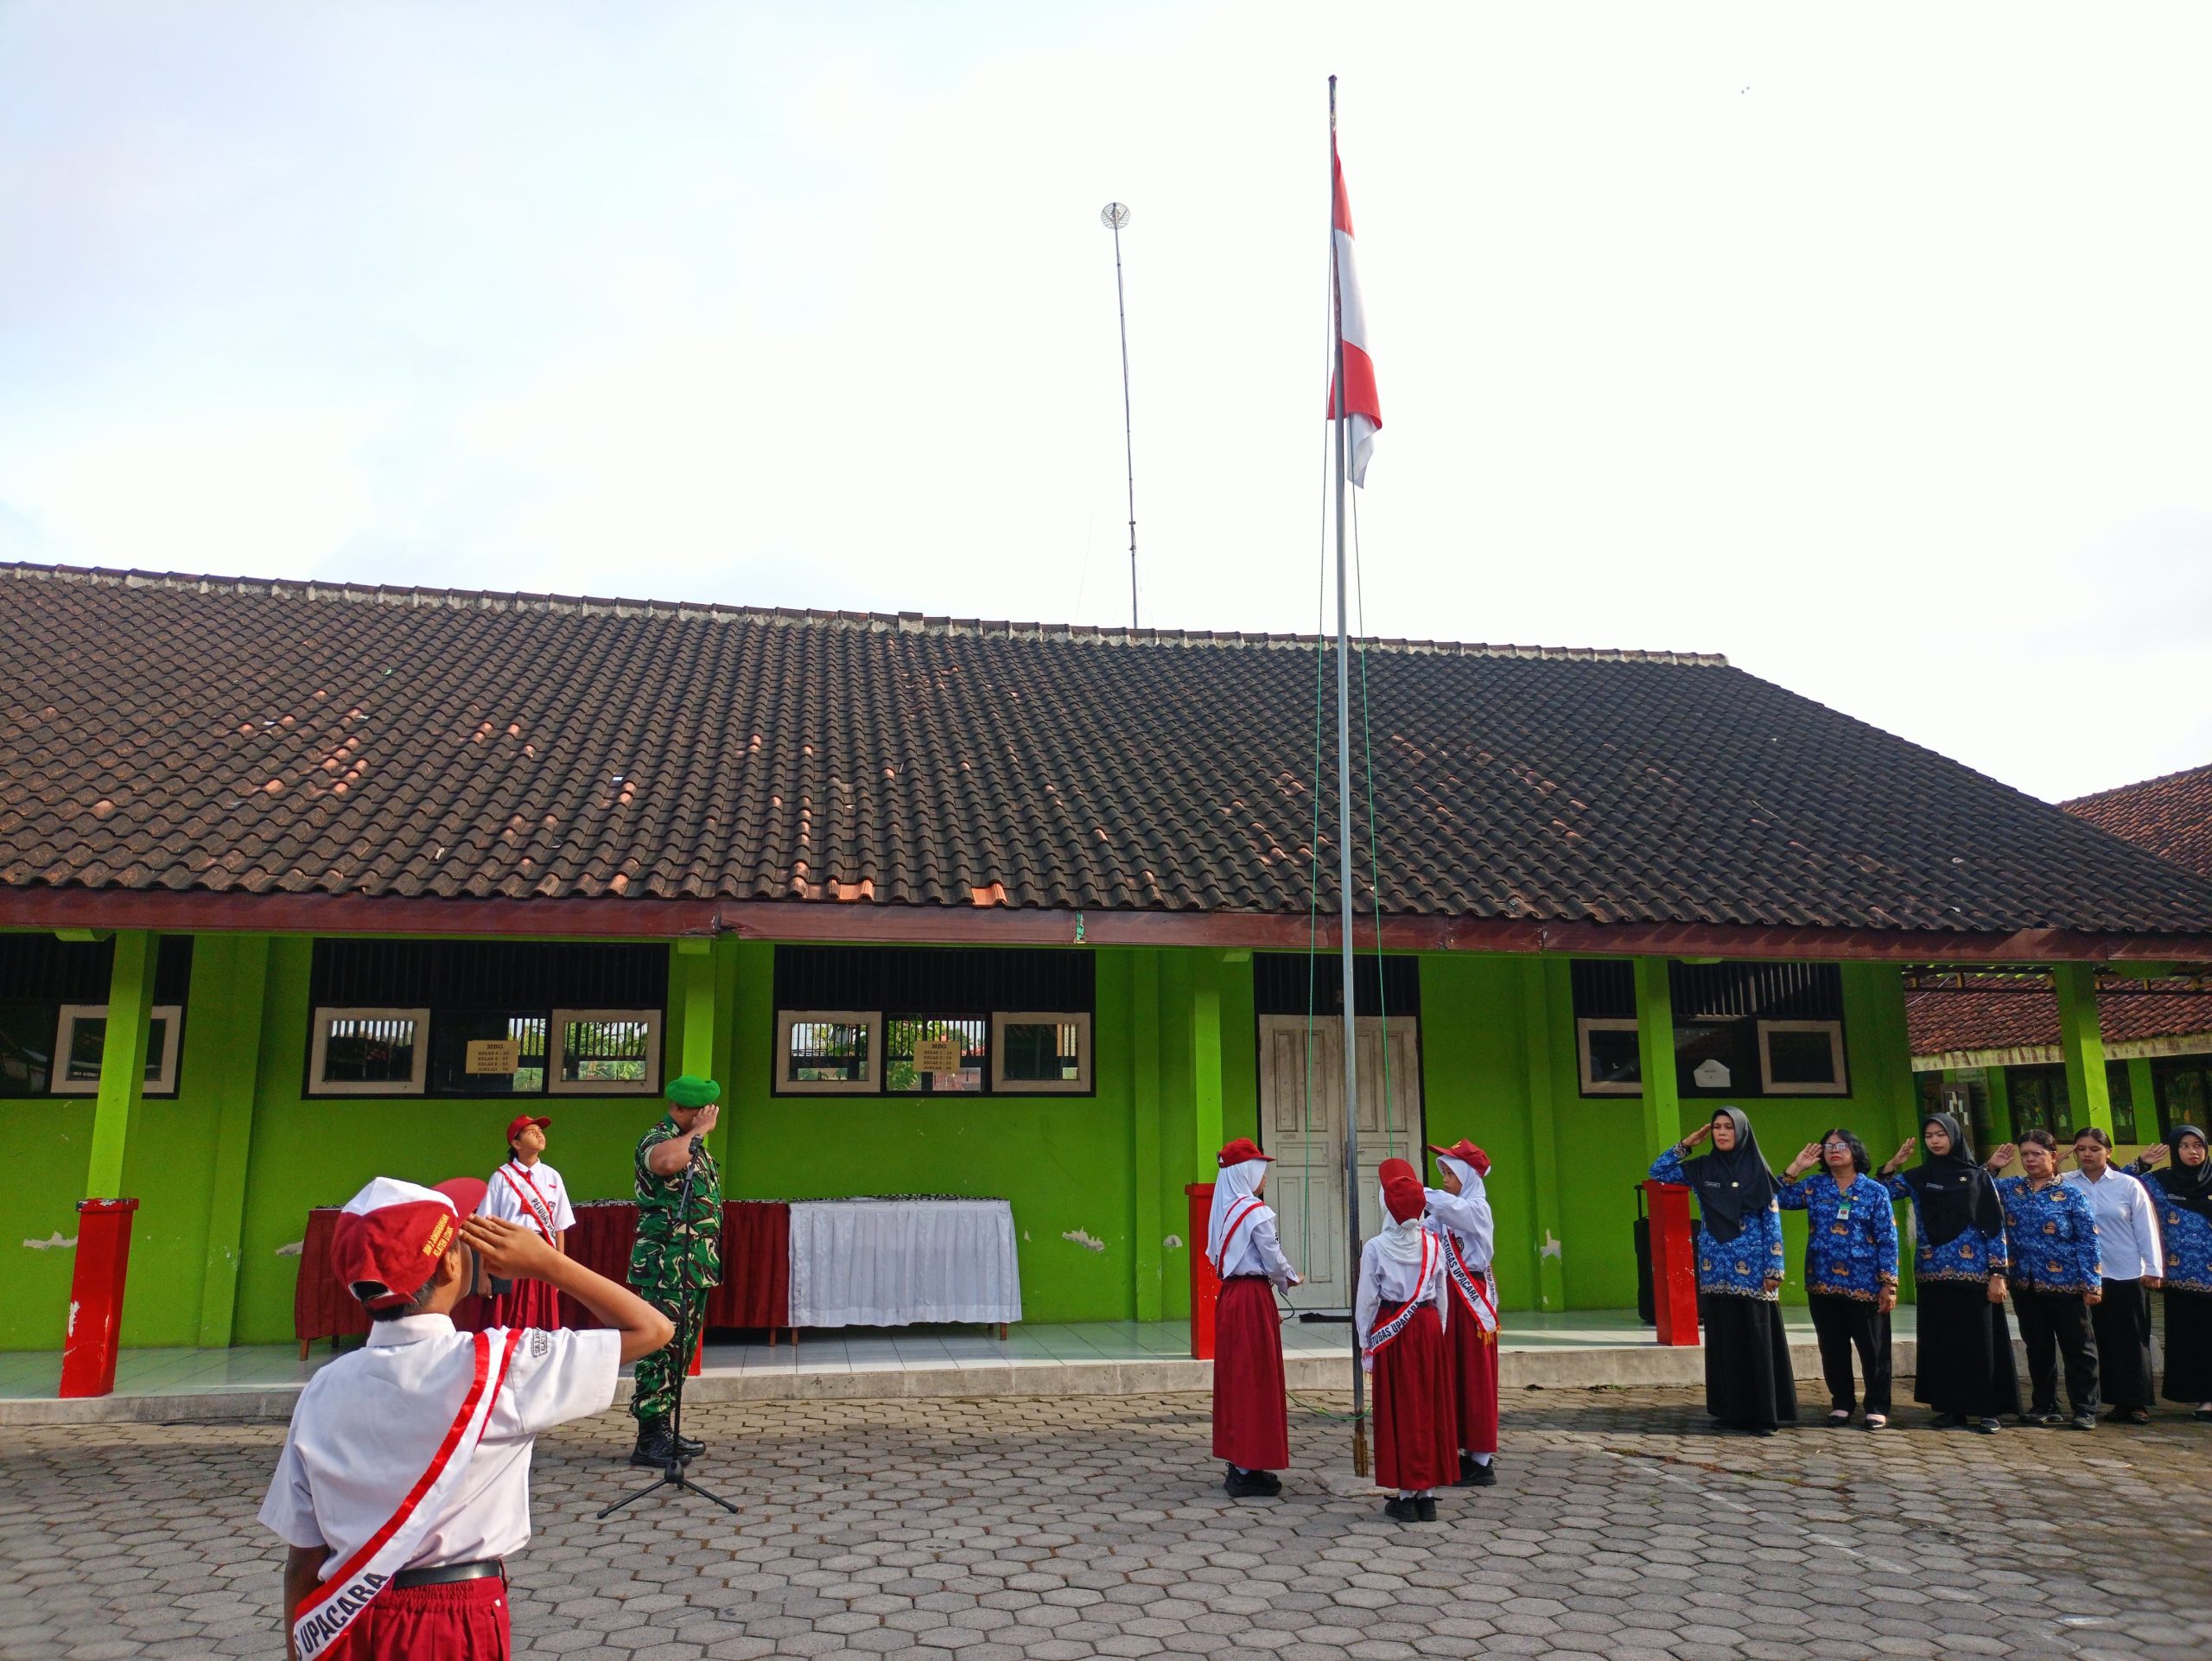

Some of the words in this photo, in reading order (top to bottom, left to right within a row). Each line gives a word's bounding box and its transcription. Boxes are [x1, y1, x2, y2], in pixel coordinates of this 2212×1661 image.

[1452, 1267, 1480, 1302] UPACARA
[1370, 1327, 1392, 1348] TUGAS
[300, 1572, 391, 1654] UPACARA
